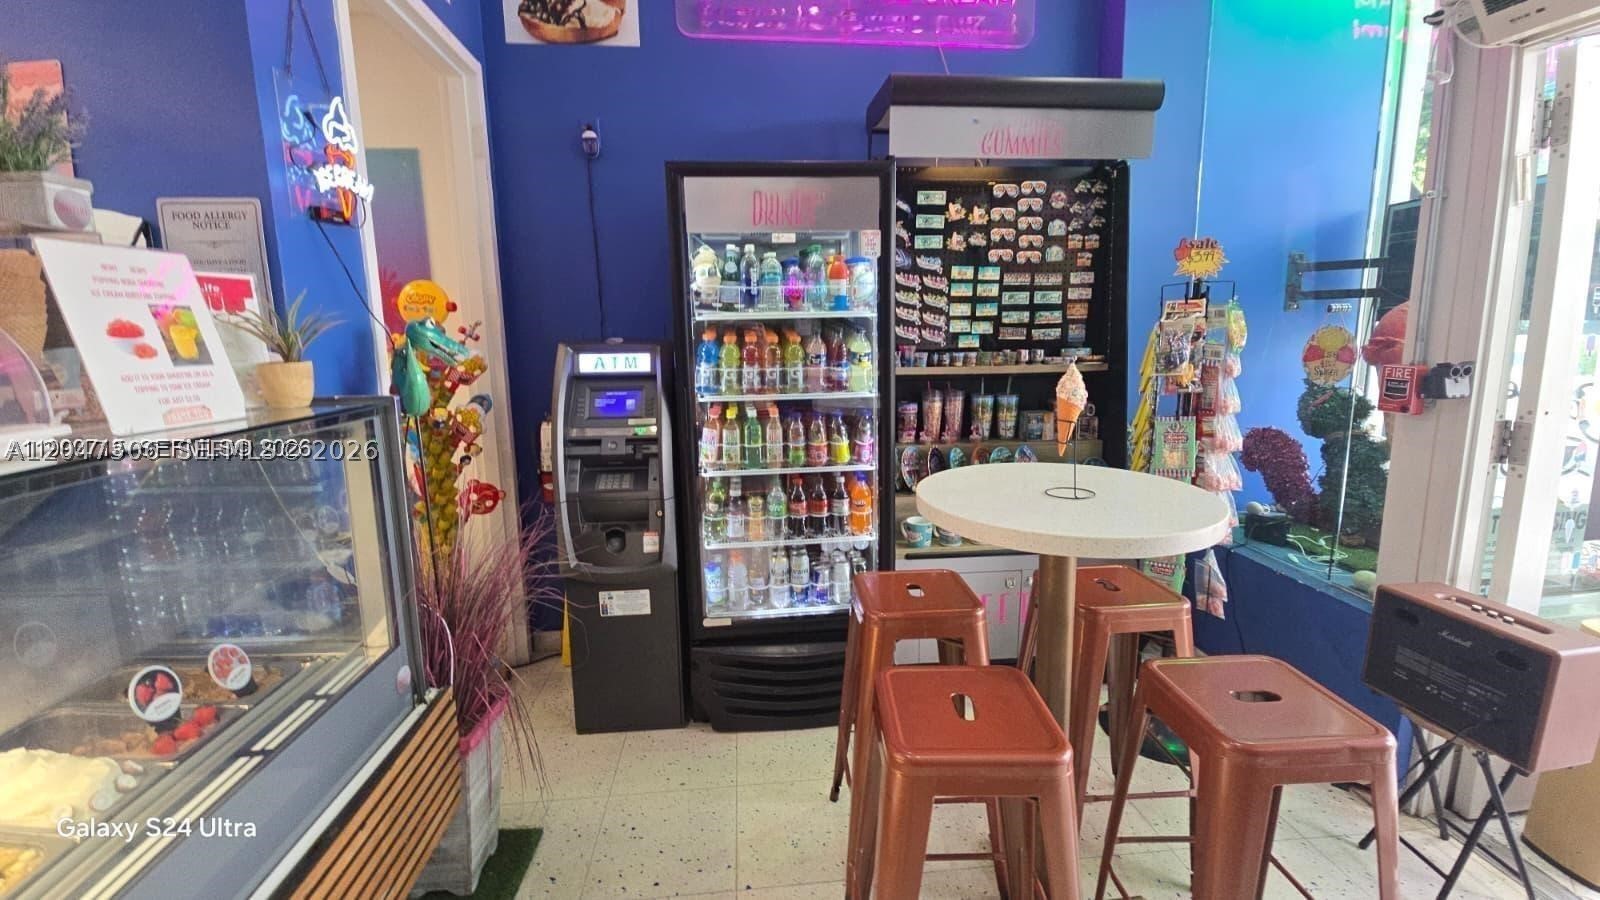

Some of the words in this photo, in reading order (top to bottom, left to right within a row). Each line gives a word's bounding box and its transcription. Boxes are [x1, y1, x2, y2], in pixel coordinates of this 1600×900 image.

[171, 210, 201, 221] FOOD
[203, 210, 248, 221] ALLERGY
[192, 220, 232, 231] NOTICE
[594, 356, 638, 370] ATM
[1385, 367, 1412, 379] FIRE
